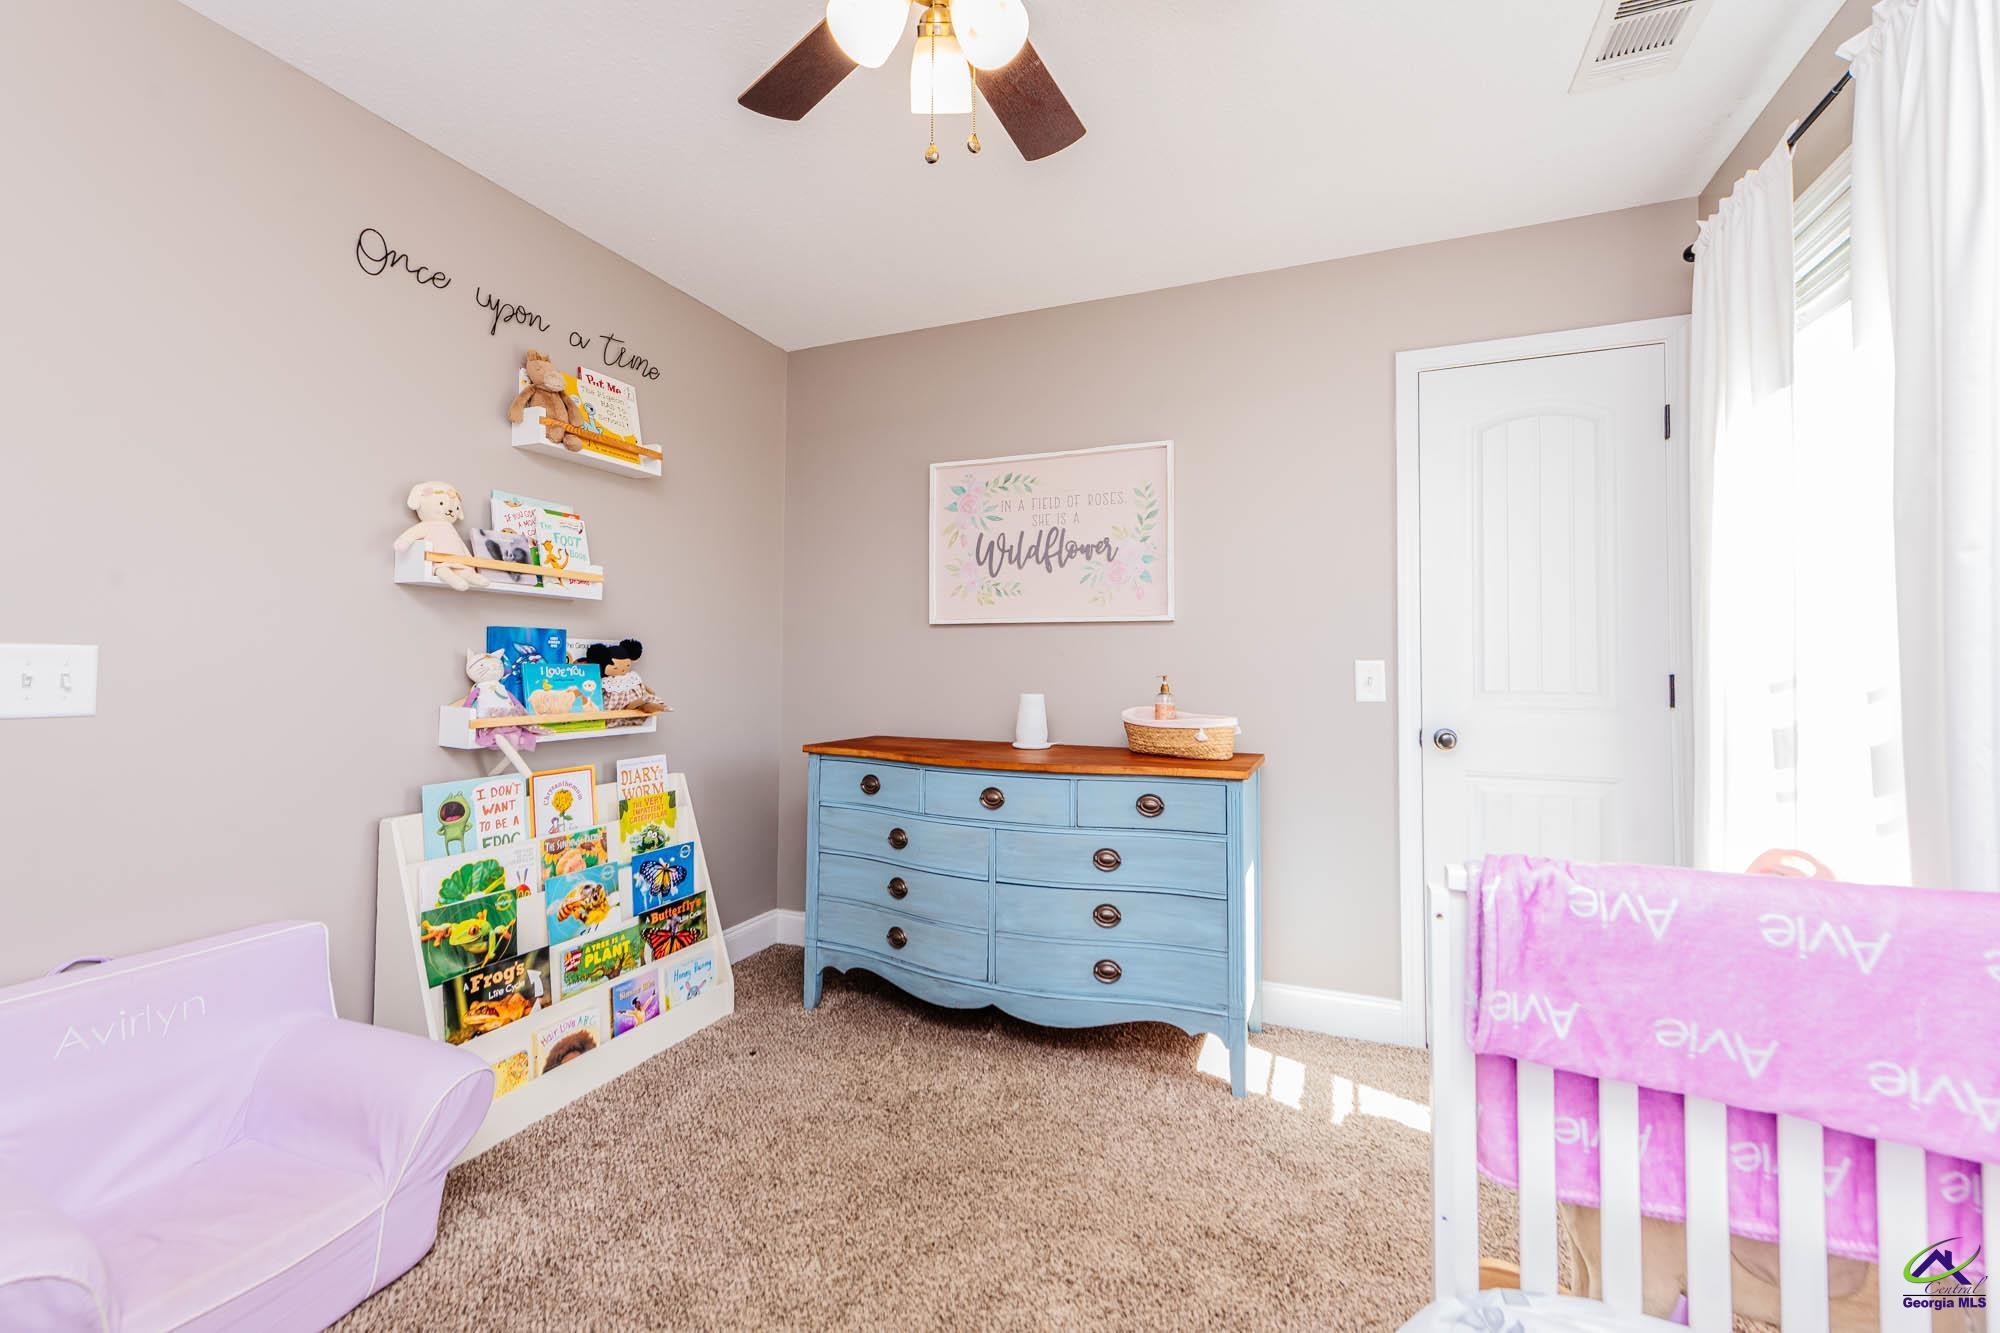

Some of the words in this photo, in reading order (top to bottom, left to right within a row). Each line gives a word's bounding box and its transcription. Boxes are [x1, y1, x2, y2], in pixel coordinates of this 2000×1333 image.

[356, 228, 451, 288] Once
[476, 287, 550, 335] upon
[569, 331, 590, 349] a
[600, 333, 660, 380] time
[1001, 500, 1012, 512] IN
[1018, 500, 1025, 512] A
[1031, 496, 1061, 511] FIELD
[1067, 494, 1080, 508] OF
[1032, 513, 1051, 527] SHE
[1057, 512, 1067, 525] IS
[1073, 511, 1080, 524] A
[553, 532, 582, 548] FOOT
[975, 526, 1119, 578] Wildflower
[540, 666, 544, 676] I
[546, 666, 567, 678] LOVE
[621, 766, 660, 786] DIARY
[476, 789, 487, 801] I
[491, 783, 521, 798] DON'T
[621, 782, 665, 800] WORM
[482, 800, 516, 816] WANT
[480, 821, 491, 833] TO
[495, 819, 507, 830] BE
[513, 815, 520, 826] A
[1567, 885, 1681, 941] Avie
[585, 946, 592, 955] A
[592, 940, 610, 952] TREE
[611, 937, 619, 947] IS
[620, 934, 626, 943] A
[585, 939, 630, 968] PLANT
[1758, 912, 1893, 976] Avie
[463, 983, 470, 993] A
[469, 961, 526, 994] Frog's
[488, 987, 504, 1000] Life
[1489, 989, 1583, 1041] Avie
[54, 995, 207, 1060] Avirlyn
[541, 1028, 559, 1047] Hair
[560, 1019, 577, 1034] Love
[577, 1015, 597, 1026] ABC
[1654, 1017, 1780, 1080] Avie
